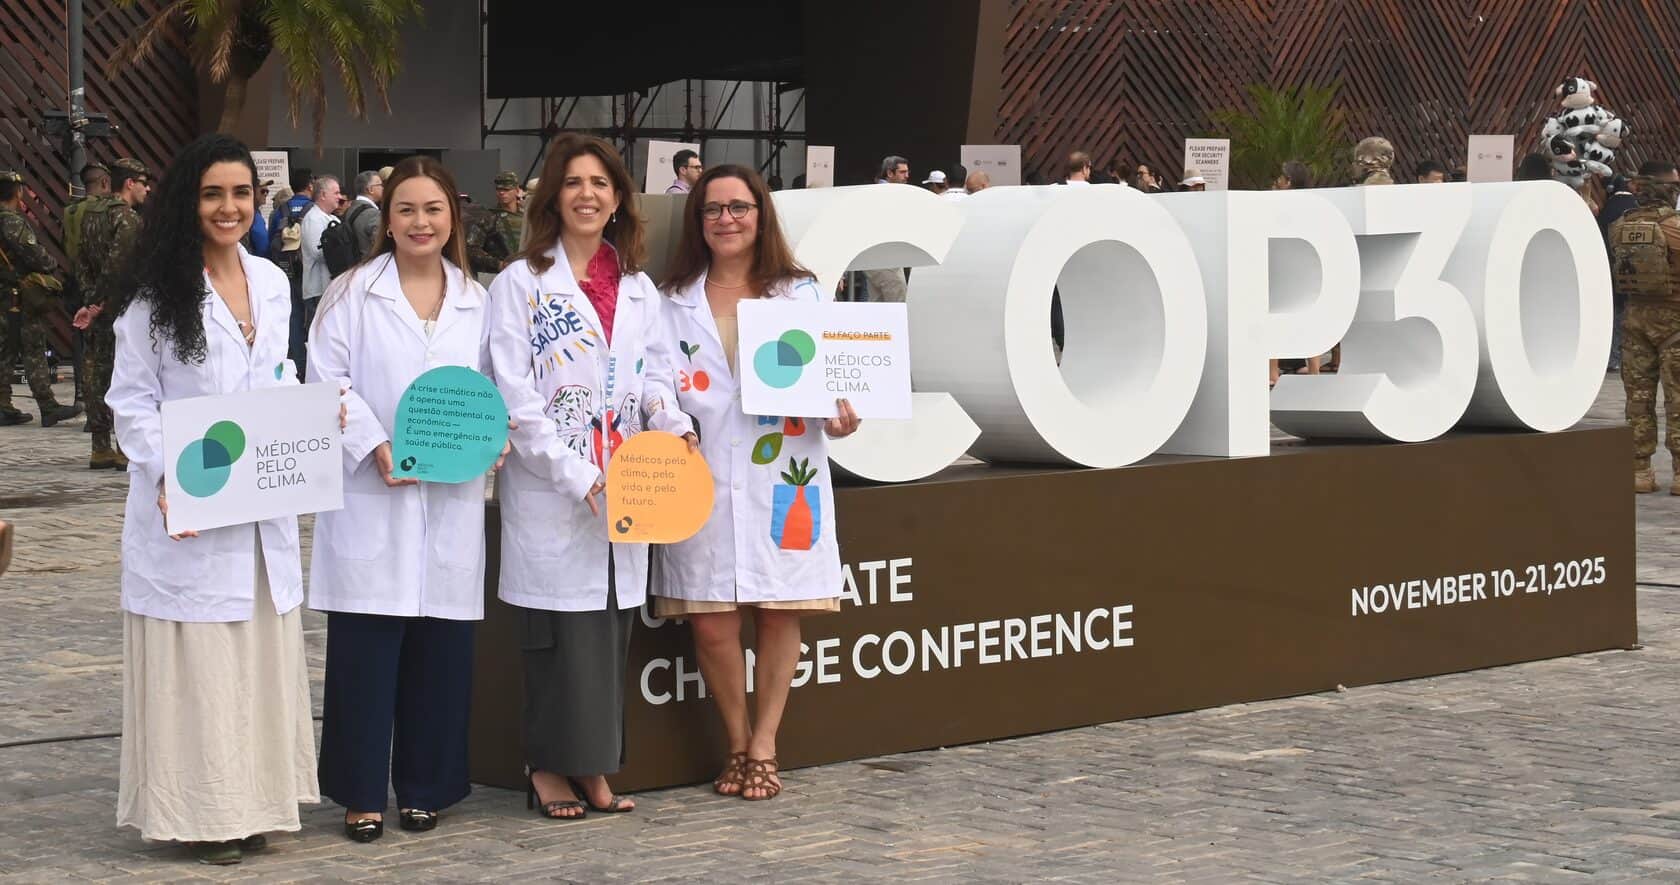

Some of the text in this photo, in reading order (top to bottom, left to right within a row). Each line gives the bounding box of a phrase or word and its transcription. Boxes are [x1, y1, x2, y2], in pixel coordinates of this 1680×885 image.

[1628, 231, 1646, 242] GPI
[530, 311, 584, 357] SAÚDE
[823, 330, 889, 340] EU FAÇO PARTE
[824, 351, 892, 367] MÉDICOS
[825, 367, 862, 380] PELO
[410, 383, 493, 399] A crise climática não
[825, 380, 871, 393] CLIMA
[416, 396, 446, 405] apenas
[408, 406, 441, 416] questão
[442, 410, 483, 420] ambiental
[407, 417, 451, 428] econômica
[413, 429, 431, 437] uma
[432, 431, 481, 441] emergência
[482, 435, 493, 443] de
[256, 437, 331, 459] MÉDICOS
[405, 438, 430, 448] saúde
[256, 457, 297, 474] PELO
[620, 455, 662, 465] Médicos
[256, 471, 306, 490] CLIMA
[620, 469, 650, 480] clima,
[621, 482, 643, 493] vida
[622, 496, 657, 507] futuro.
[1351, 572, 1487, 617] NOVEMBER
[640, 604, 1134, 706] CHGE CONFERENCE
